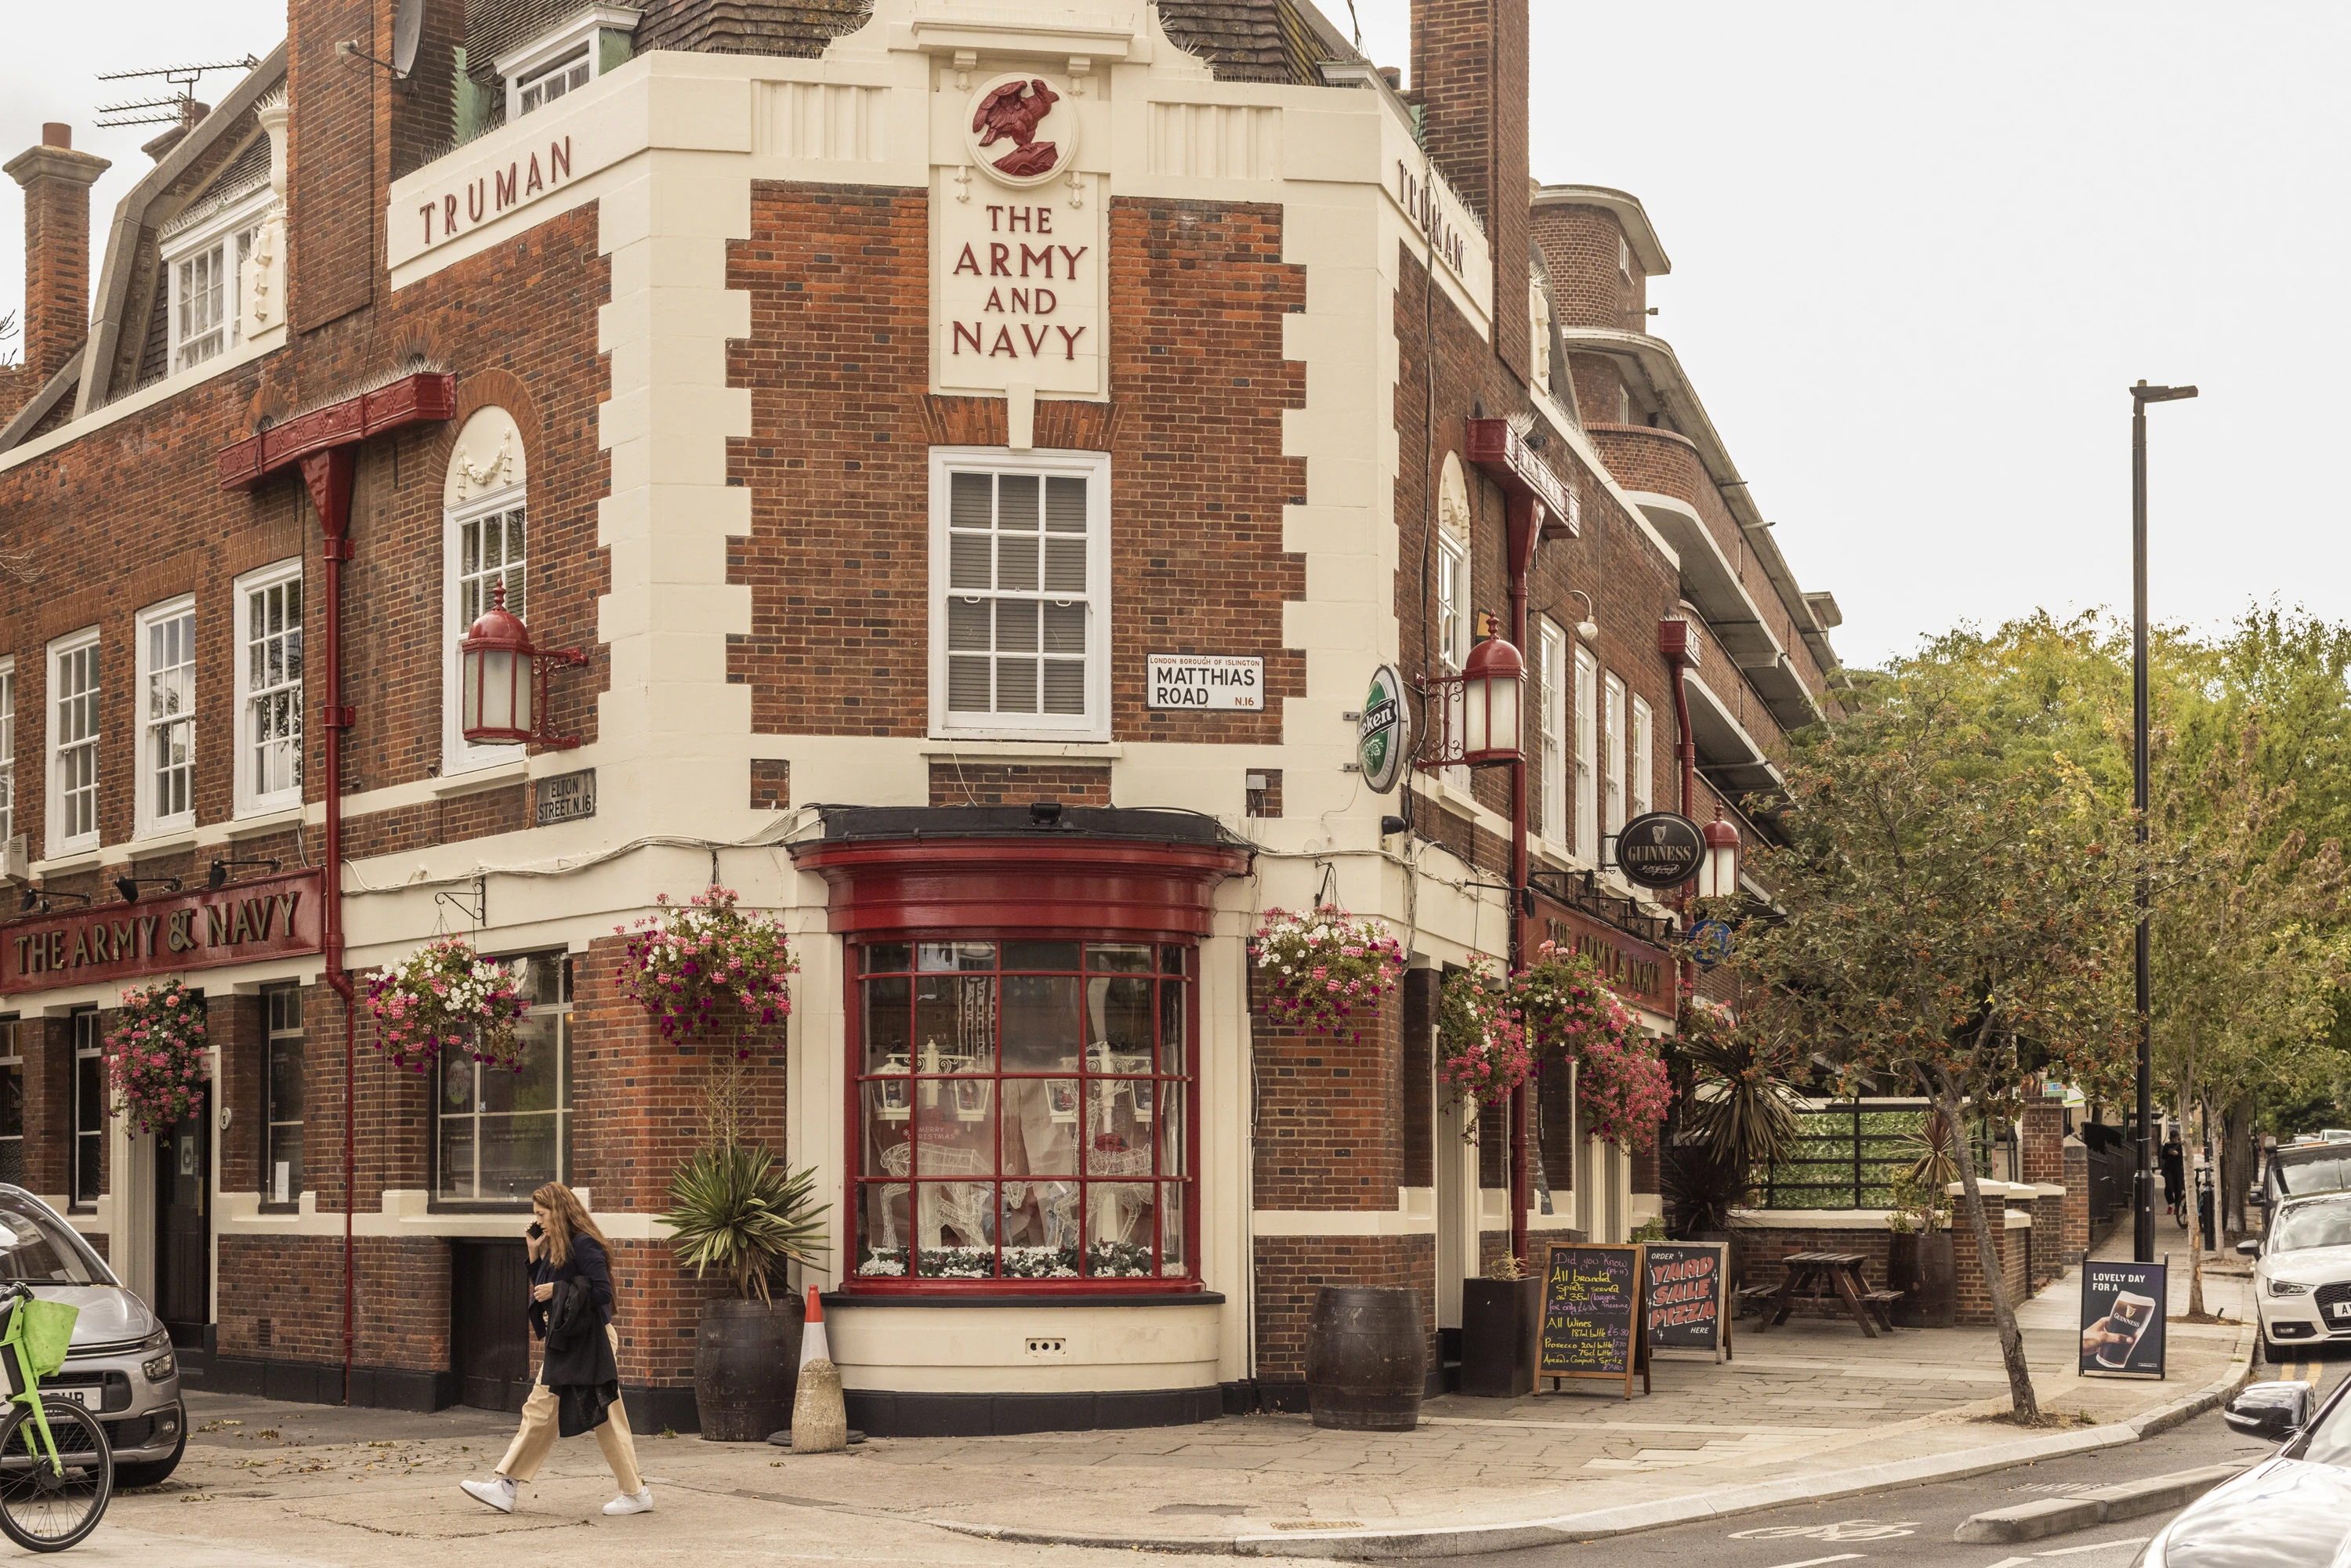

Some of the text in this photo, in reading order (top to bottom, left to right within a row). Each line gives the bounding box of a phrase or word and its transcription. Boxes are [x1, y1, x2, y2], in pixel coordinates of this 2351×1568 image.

[419, 136, 571, 244] TRUMAN
[986, 205, 1052, 234] THE
[1398, 159, 1464, 278] TRUMAN
[952, 241, 1089, 280] ARMY
[984, 286, 1056, 314] AND
[952, 320, 1087, 360] NAVY
[1157, 667, 1255, 686] MATTHIAS
[1157, 686, 1254, 706] ROAD N.16
[551, 777, 579, 798] ELTON
[1628, 846, 1692, 862] GUINNESS
[14, 891, 299, 975] THE ARMY & NAVY
[1578, 930, 1614, 977] ARMY
[1632, 953, 1662, 999] NAVY
[1554, 1252, 1628, 1270] Did you Know
[1650, 1256, 1714, 1285] YARD
[1550, 1266, 1611, 1284] All branded
[2092, 1273, 2146, 1283] LOVELY DAY
[1590, 1284, 1620, 1293] served
[1653, 1278, 1711, 1306] SALE
[2092, 1283, 2110, 1291] FOR
[1549, 1299, 1560, 1313] for
[1563, 1302, 1577, 1316] only
[1648, 1301, 1716, 1330] PIZZA
[2342, 1304, 2351, 1315] A
[1546, 1316, 1592, 1329] All Wines
[2114, 1313, 2140, 1327] GUINNESS
[1589, 1327, 1607, 1338] bottle
[1545, 1338, 1578, 1349] Prosecco
[1599, 1356, 1623, 1365] Spritz
